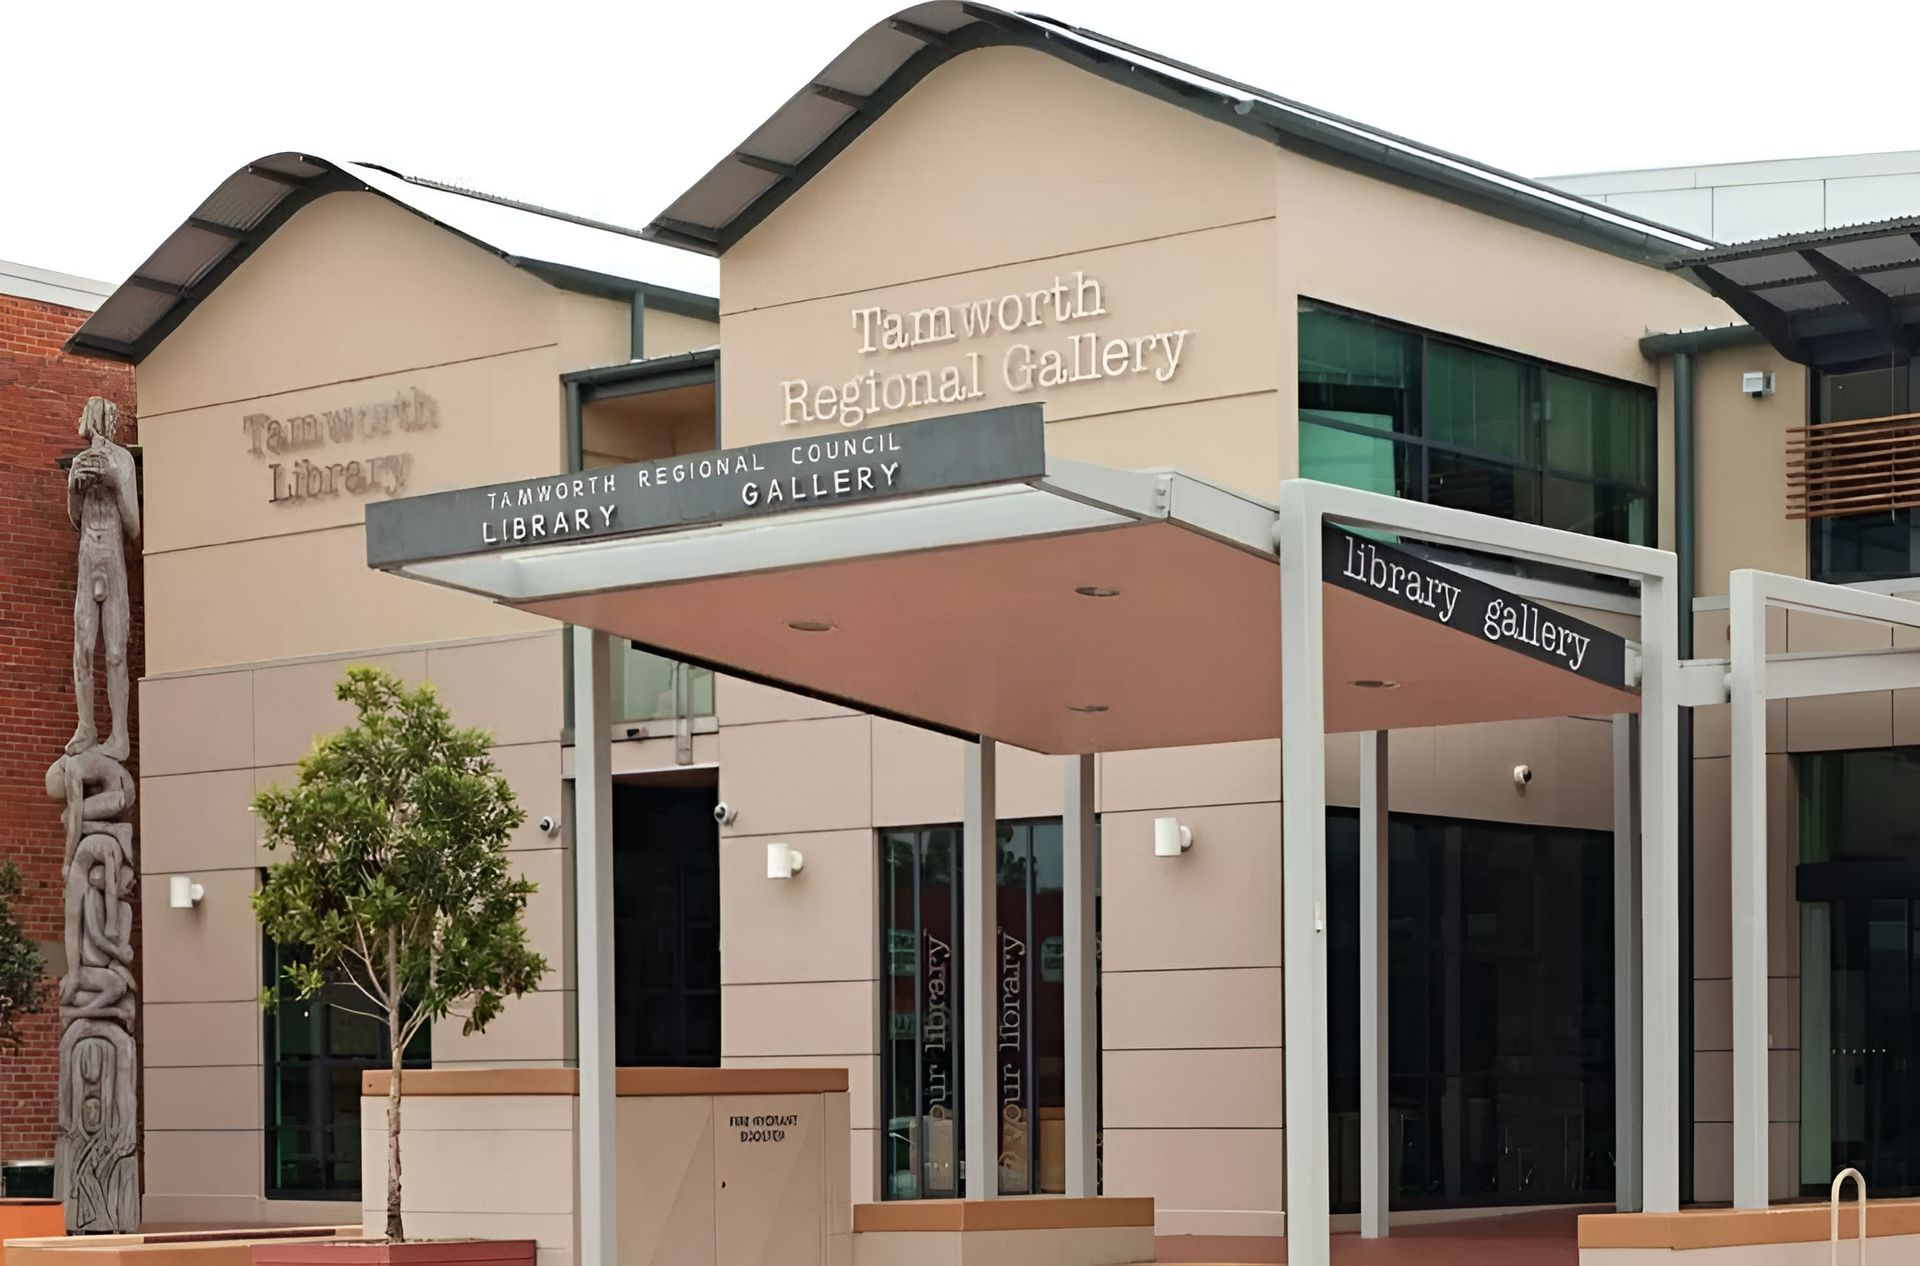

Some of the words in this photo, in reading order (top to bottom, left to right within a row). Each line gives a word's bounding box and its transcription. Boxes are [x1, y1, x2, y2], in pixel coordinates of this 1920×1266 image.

[851, 271, 1107, 354] Tamworth
[780, 352, 985, 428] Regional
[1002, 329, 1196, 393] Gallery
[268, 452, 414, 504] Library
[483, 504, 617, 544] LIBRARY
[742, 462, 900, 507] GALLERY
[487, 474, 617, 511] TAMWORTH
[638, 453, 766, 488] REGIONAL
[791, 431, 901, 465] COUNCIL
[1343, 535, 1461, 623] library
[1483, 598, 1590, 671] gallery
[923, 928, 951, 1053] library
[997, 926, 1026, 1053] library
